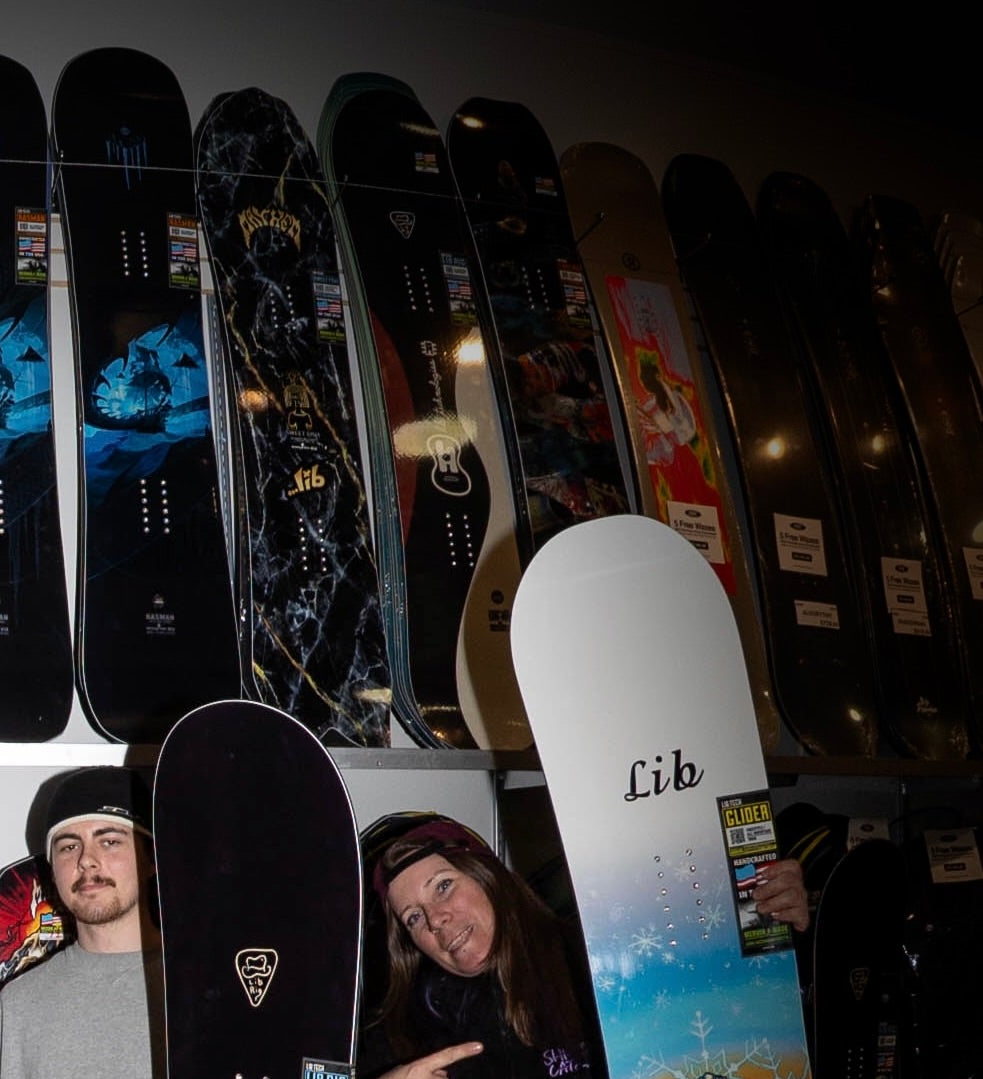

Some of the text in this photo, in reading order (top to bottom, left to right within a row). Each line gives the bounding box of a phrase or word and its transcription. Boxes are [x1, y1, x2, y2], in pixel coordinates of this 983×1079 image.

[624, 748, 704, 802] Lib
[725, 804, 770, 826] GLIDER
[733, 853, 777, 866] HANDCRAFTED
